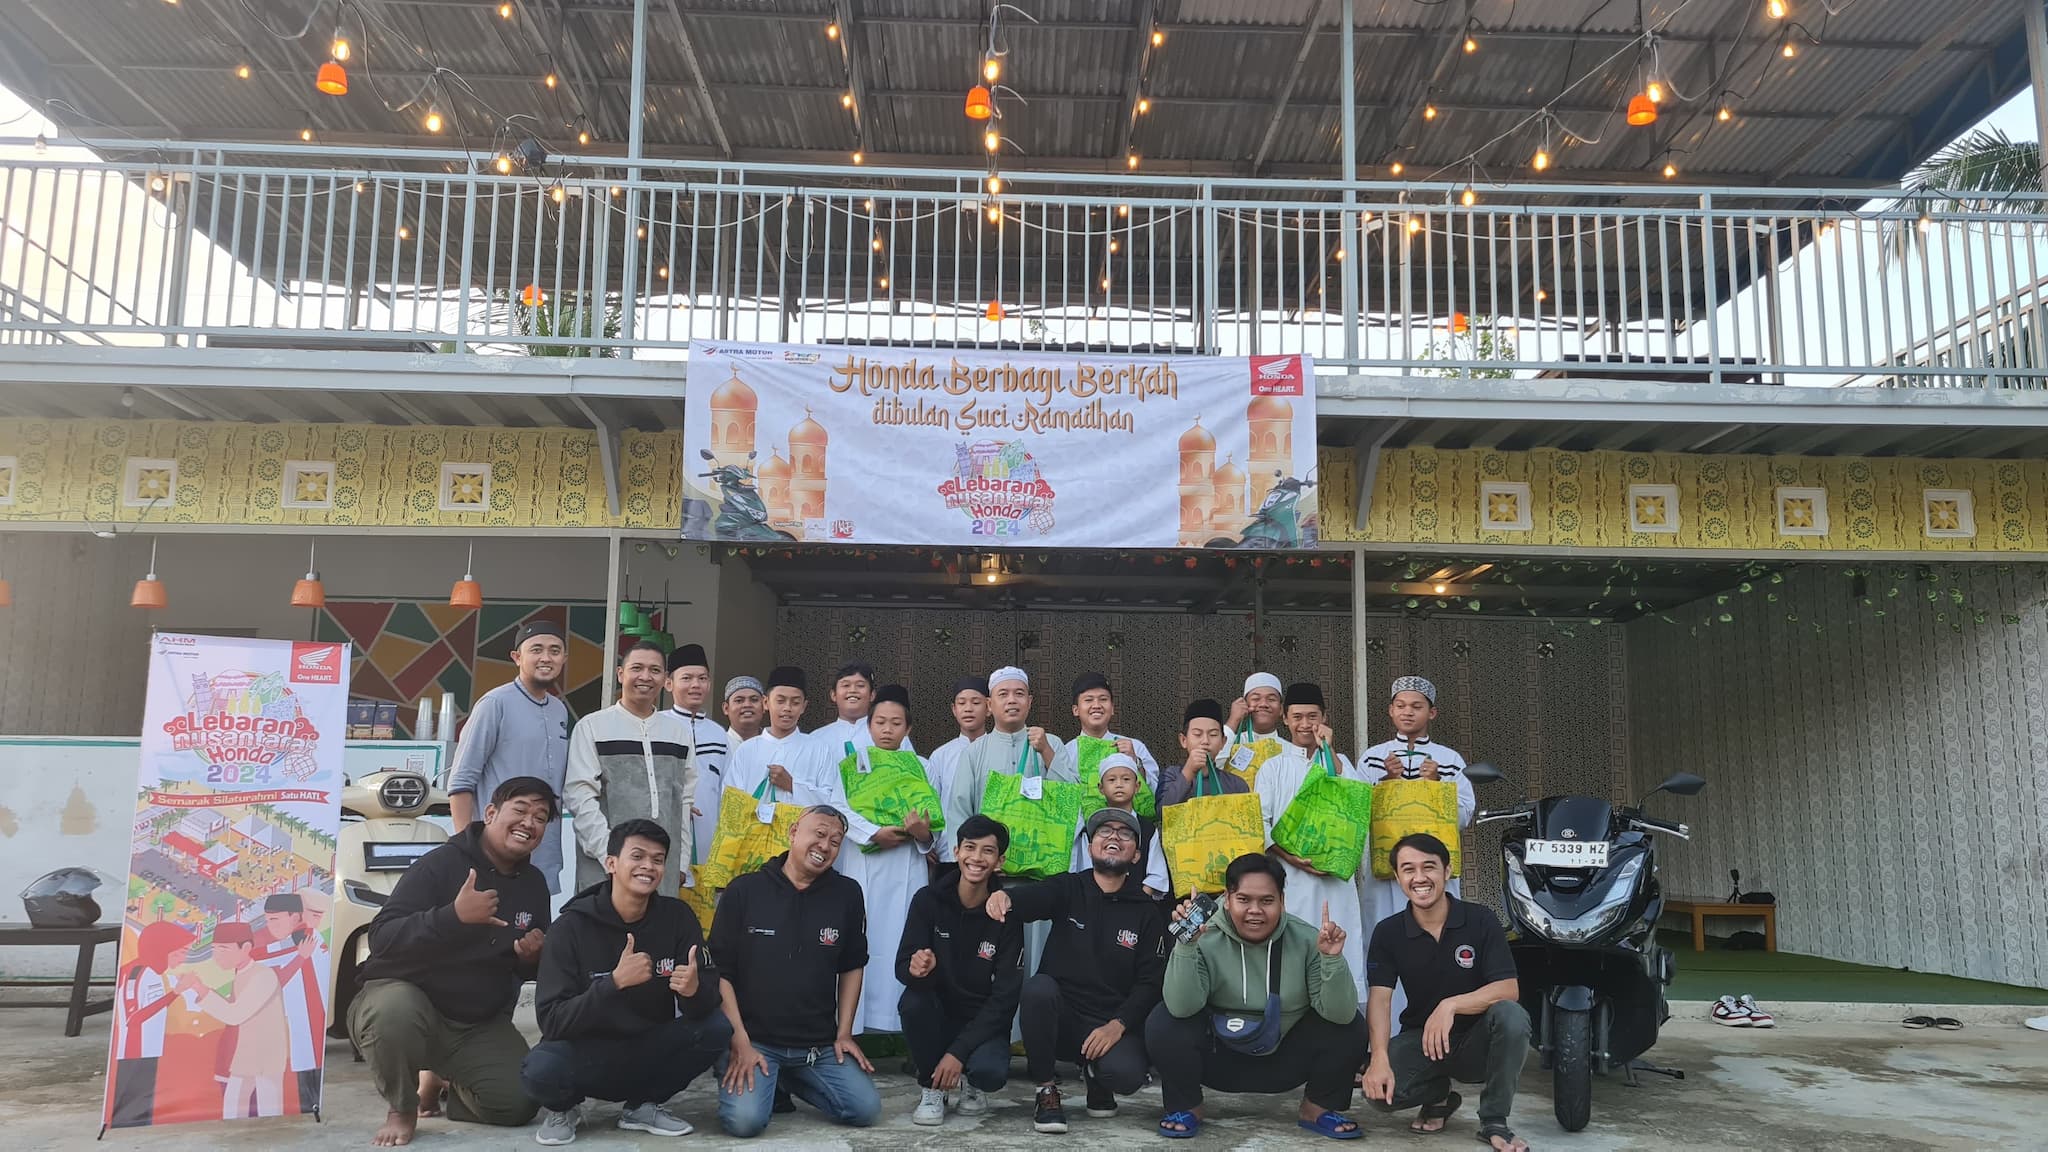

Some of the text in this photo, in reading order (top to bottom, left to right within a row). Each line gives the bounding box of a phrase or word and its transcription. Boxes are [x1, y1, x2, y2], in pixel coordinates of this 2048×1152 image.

[829, 354, 1178, 406] Honda Berbagi Berkah
[872, 397, 1134, 436] dibulan Suci Ramadhan
[954, 475, 1035, 496] Lebaran
[970, 503, 1022, 519] Honda
[971, 519, 1020, 536] 2024
[187, 711, 295, 737] Lebaran
[206, 745, 276, 764] Honda
[207, 765, 272, 783] 2024
[157, 794, 209, 806] Semarak
[213, 792, 277, 805] Silaturahmi
[280, 790, 298, 800] Satu
[1529, 842, 1605, 854] KT 5339 HZ
